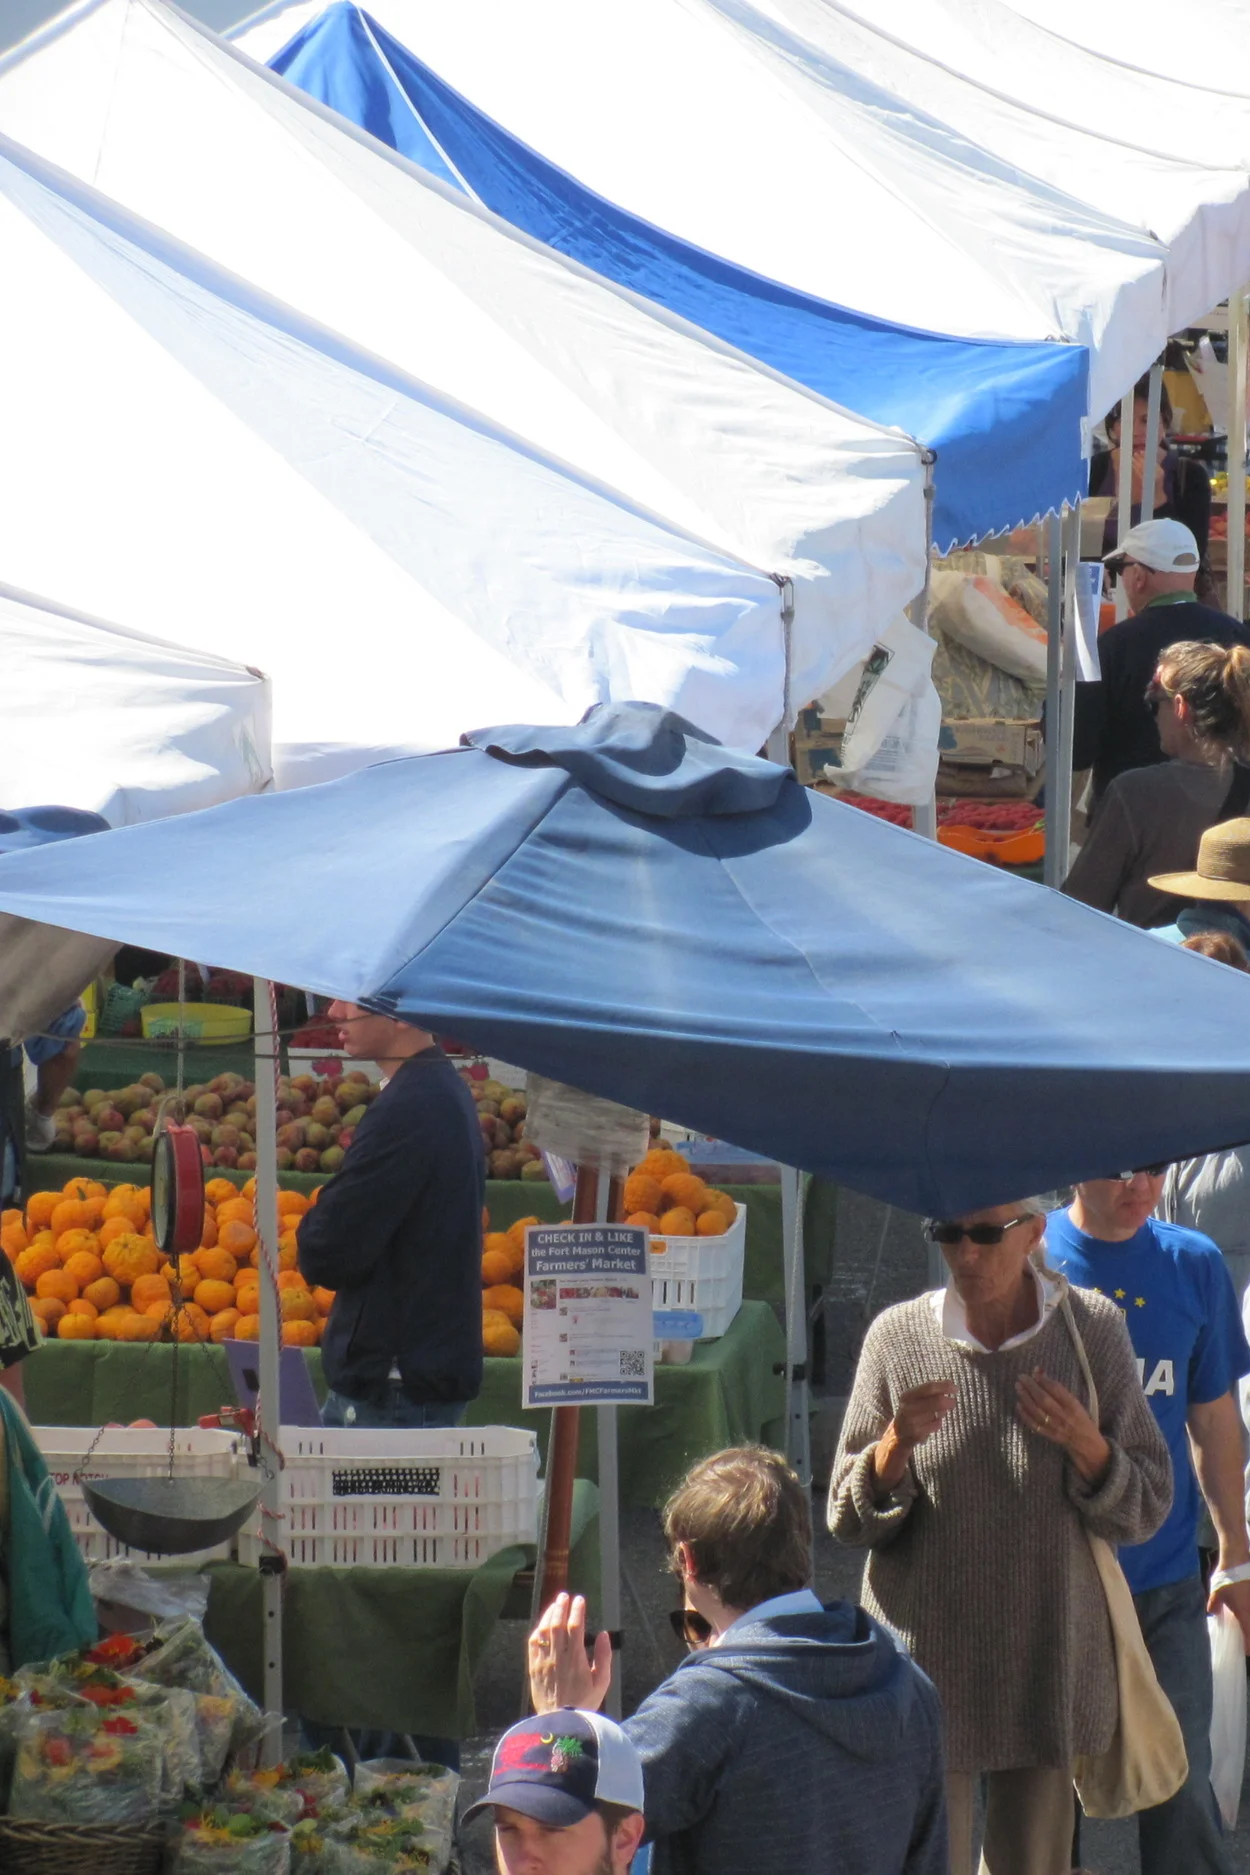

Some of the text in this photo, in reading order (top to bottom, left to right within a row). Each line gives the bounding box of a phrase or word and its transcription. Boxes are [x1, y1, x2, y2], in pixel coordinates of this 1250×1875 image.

[537, 1231, 634, 1244] CHECK IN & LIKE
[531, 1245, 641, 1257] the Fort Mason Center
[536, 1258, 636, 1271] Farmers' Market
